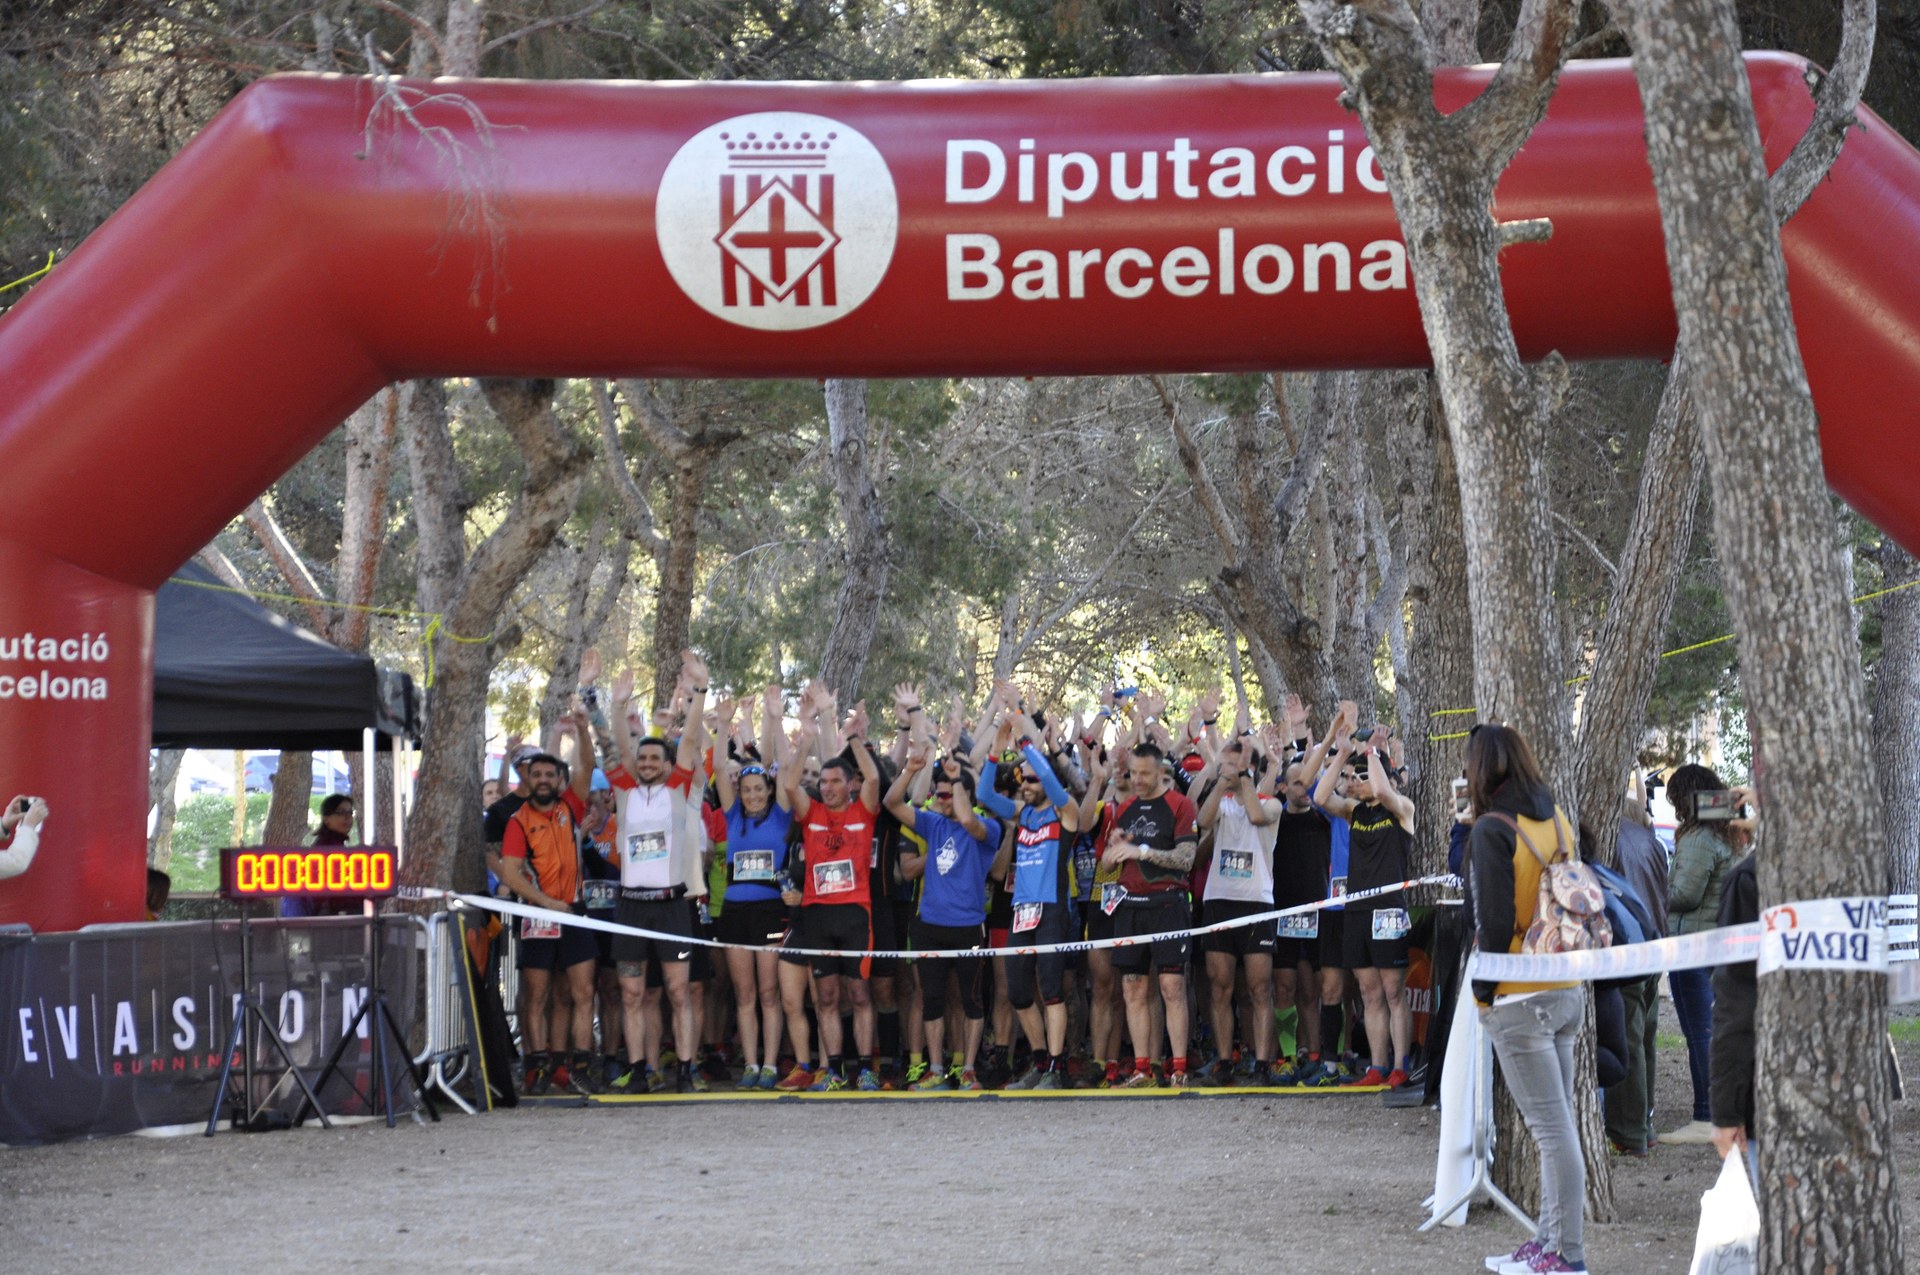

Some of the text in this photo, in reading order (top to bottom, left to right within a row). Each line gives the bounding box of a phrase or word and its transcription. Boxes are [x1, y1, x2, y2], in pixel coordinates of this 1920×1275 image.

[945, 227, 1408, 301] Barcelona
[592, 887, 614, 899] 413
[1287, 916, 1309, 929] 335
[1780, 931, 1869, 962] BBVA
